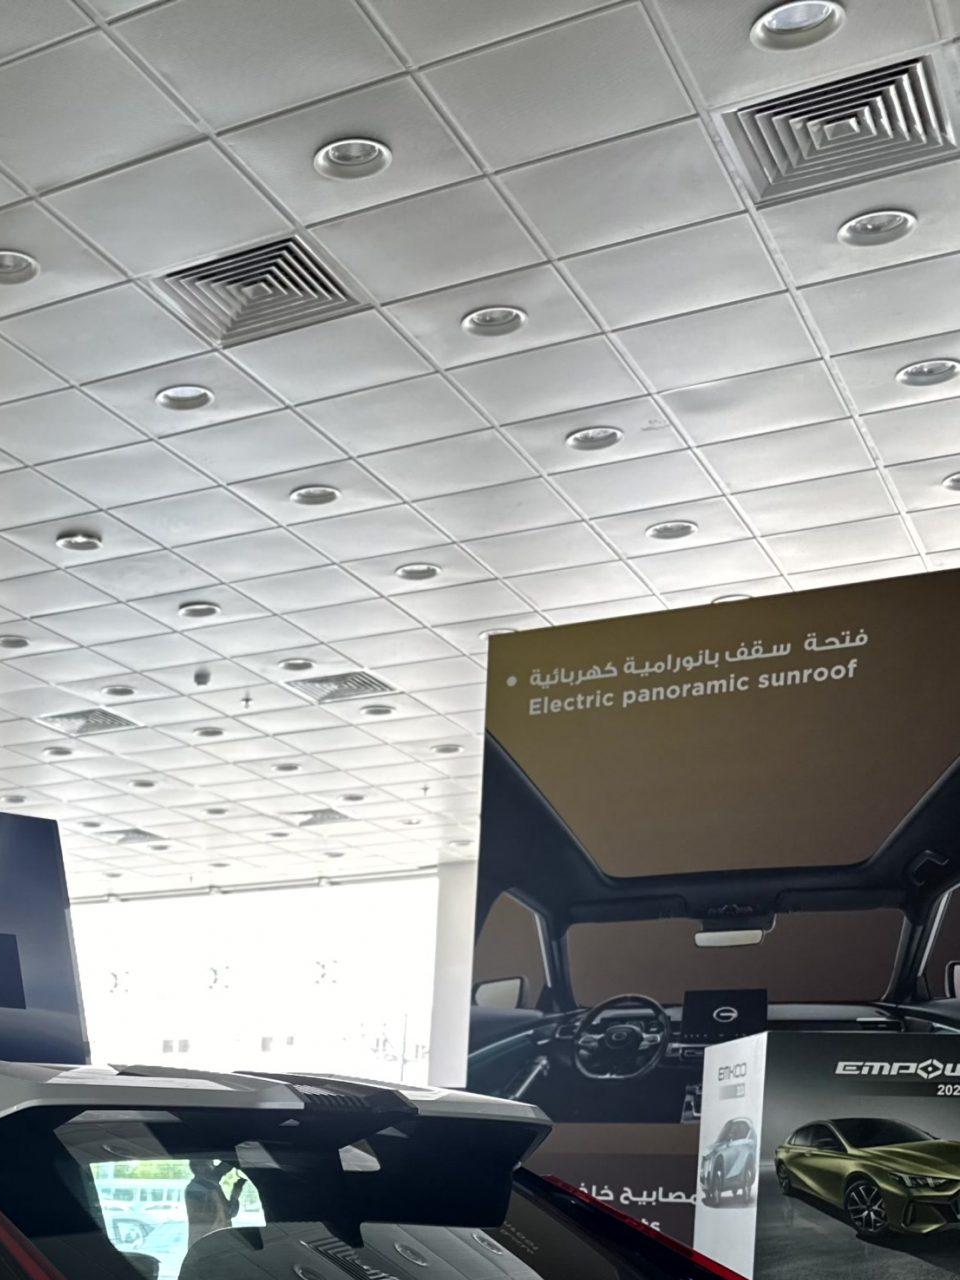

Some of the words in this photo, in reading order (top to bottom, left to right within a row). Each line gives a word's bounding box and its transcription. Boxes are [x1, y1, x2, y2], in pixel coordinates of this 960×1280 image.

[724, 640, 792, 662] سقف
[803, 629, 870, 652] فتحة
[529, 661, 619, 689] كهربائية
[622, 649, 720, 677] بانورامية
[528, 689, 614, 716] Electric
[622, 673, 749, 708] panoramic
[757, 659, 859, 689] sunroof
